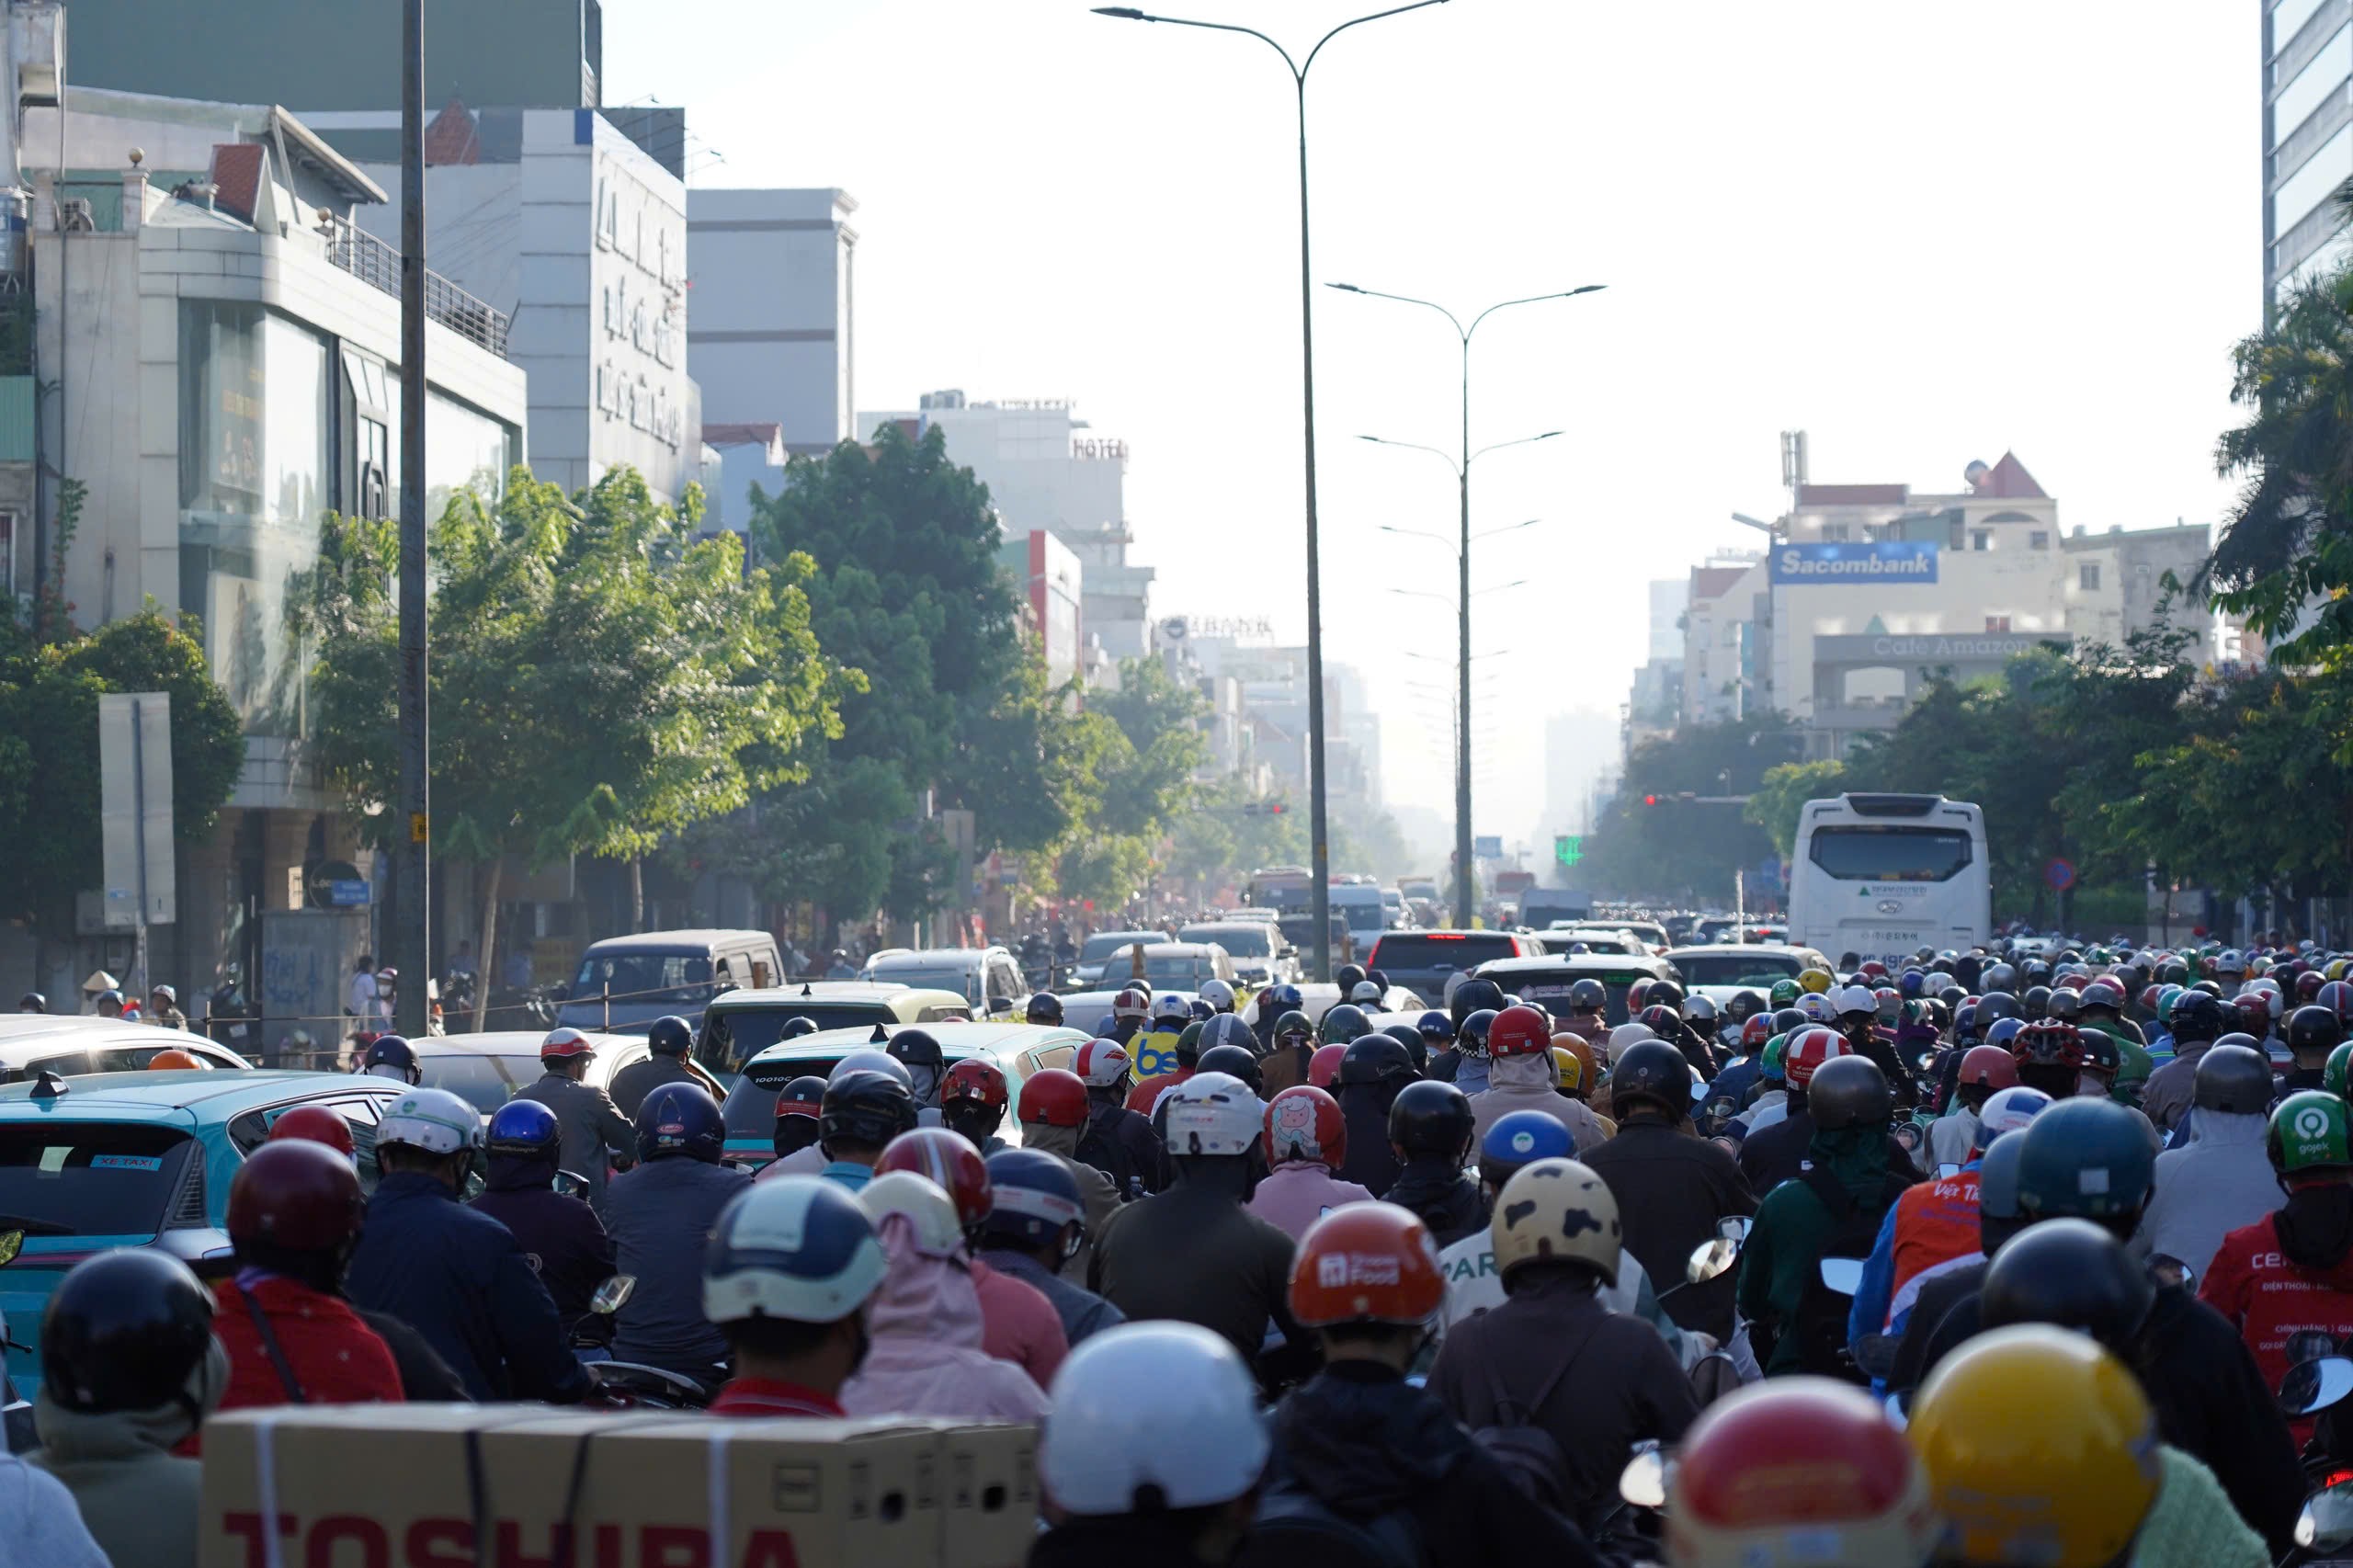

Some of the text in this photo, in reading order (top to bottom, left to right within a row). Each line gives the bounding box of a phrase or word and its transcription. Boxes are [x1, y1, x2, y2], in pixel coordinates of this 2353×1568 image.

[1781, 550, 1929, 574] Sacombank
[1935, 636, 2030, 655] Amazon
[1136, 1039, 1178, 1076] be
[755, 1075, 792, 1084] 10010C
[2299, 1142, 2330, 1155] gojek
[100, 1157, 153, 1167] XE TAXI
[1351, 1267, 1399, 1286] Food
[2283, 1281, 2311, 1292] THOẠI
[223, 1512, 804, 1568] TOSHIBA
